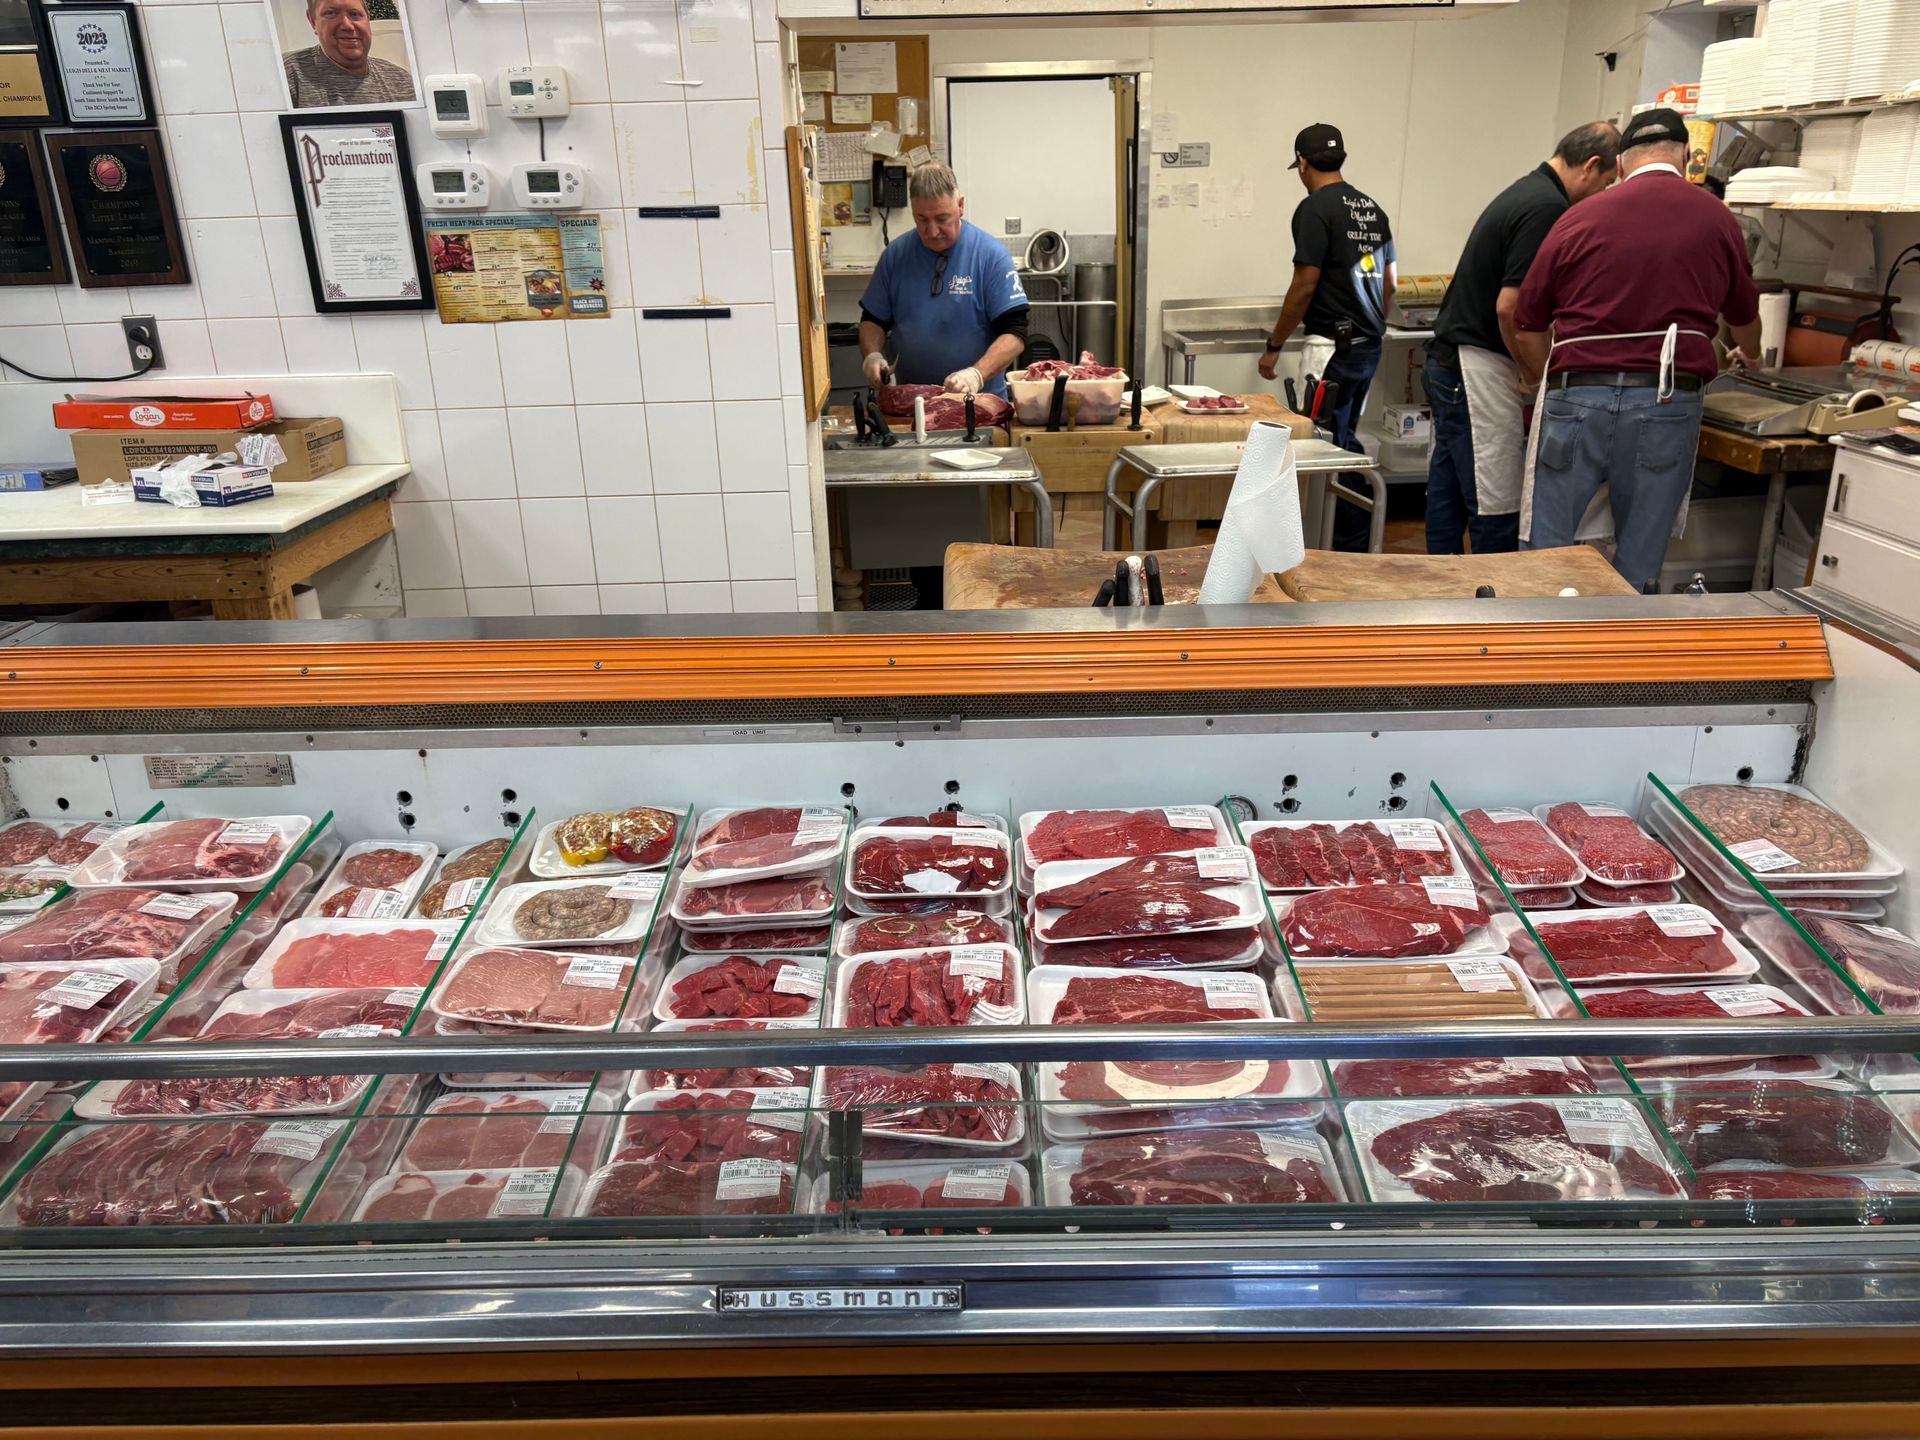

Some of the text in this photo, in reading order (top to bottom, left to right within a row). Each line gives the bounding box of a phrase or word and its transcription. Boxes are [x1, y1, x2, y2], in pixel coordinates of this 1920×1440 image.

[77, 32, 108, 45] 2023
[561, 219, 598, 227] SPECIALS
[134, 410, 161, 420] Logan
[733, 1291, 948, 1308] HUSSMANN
